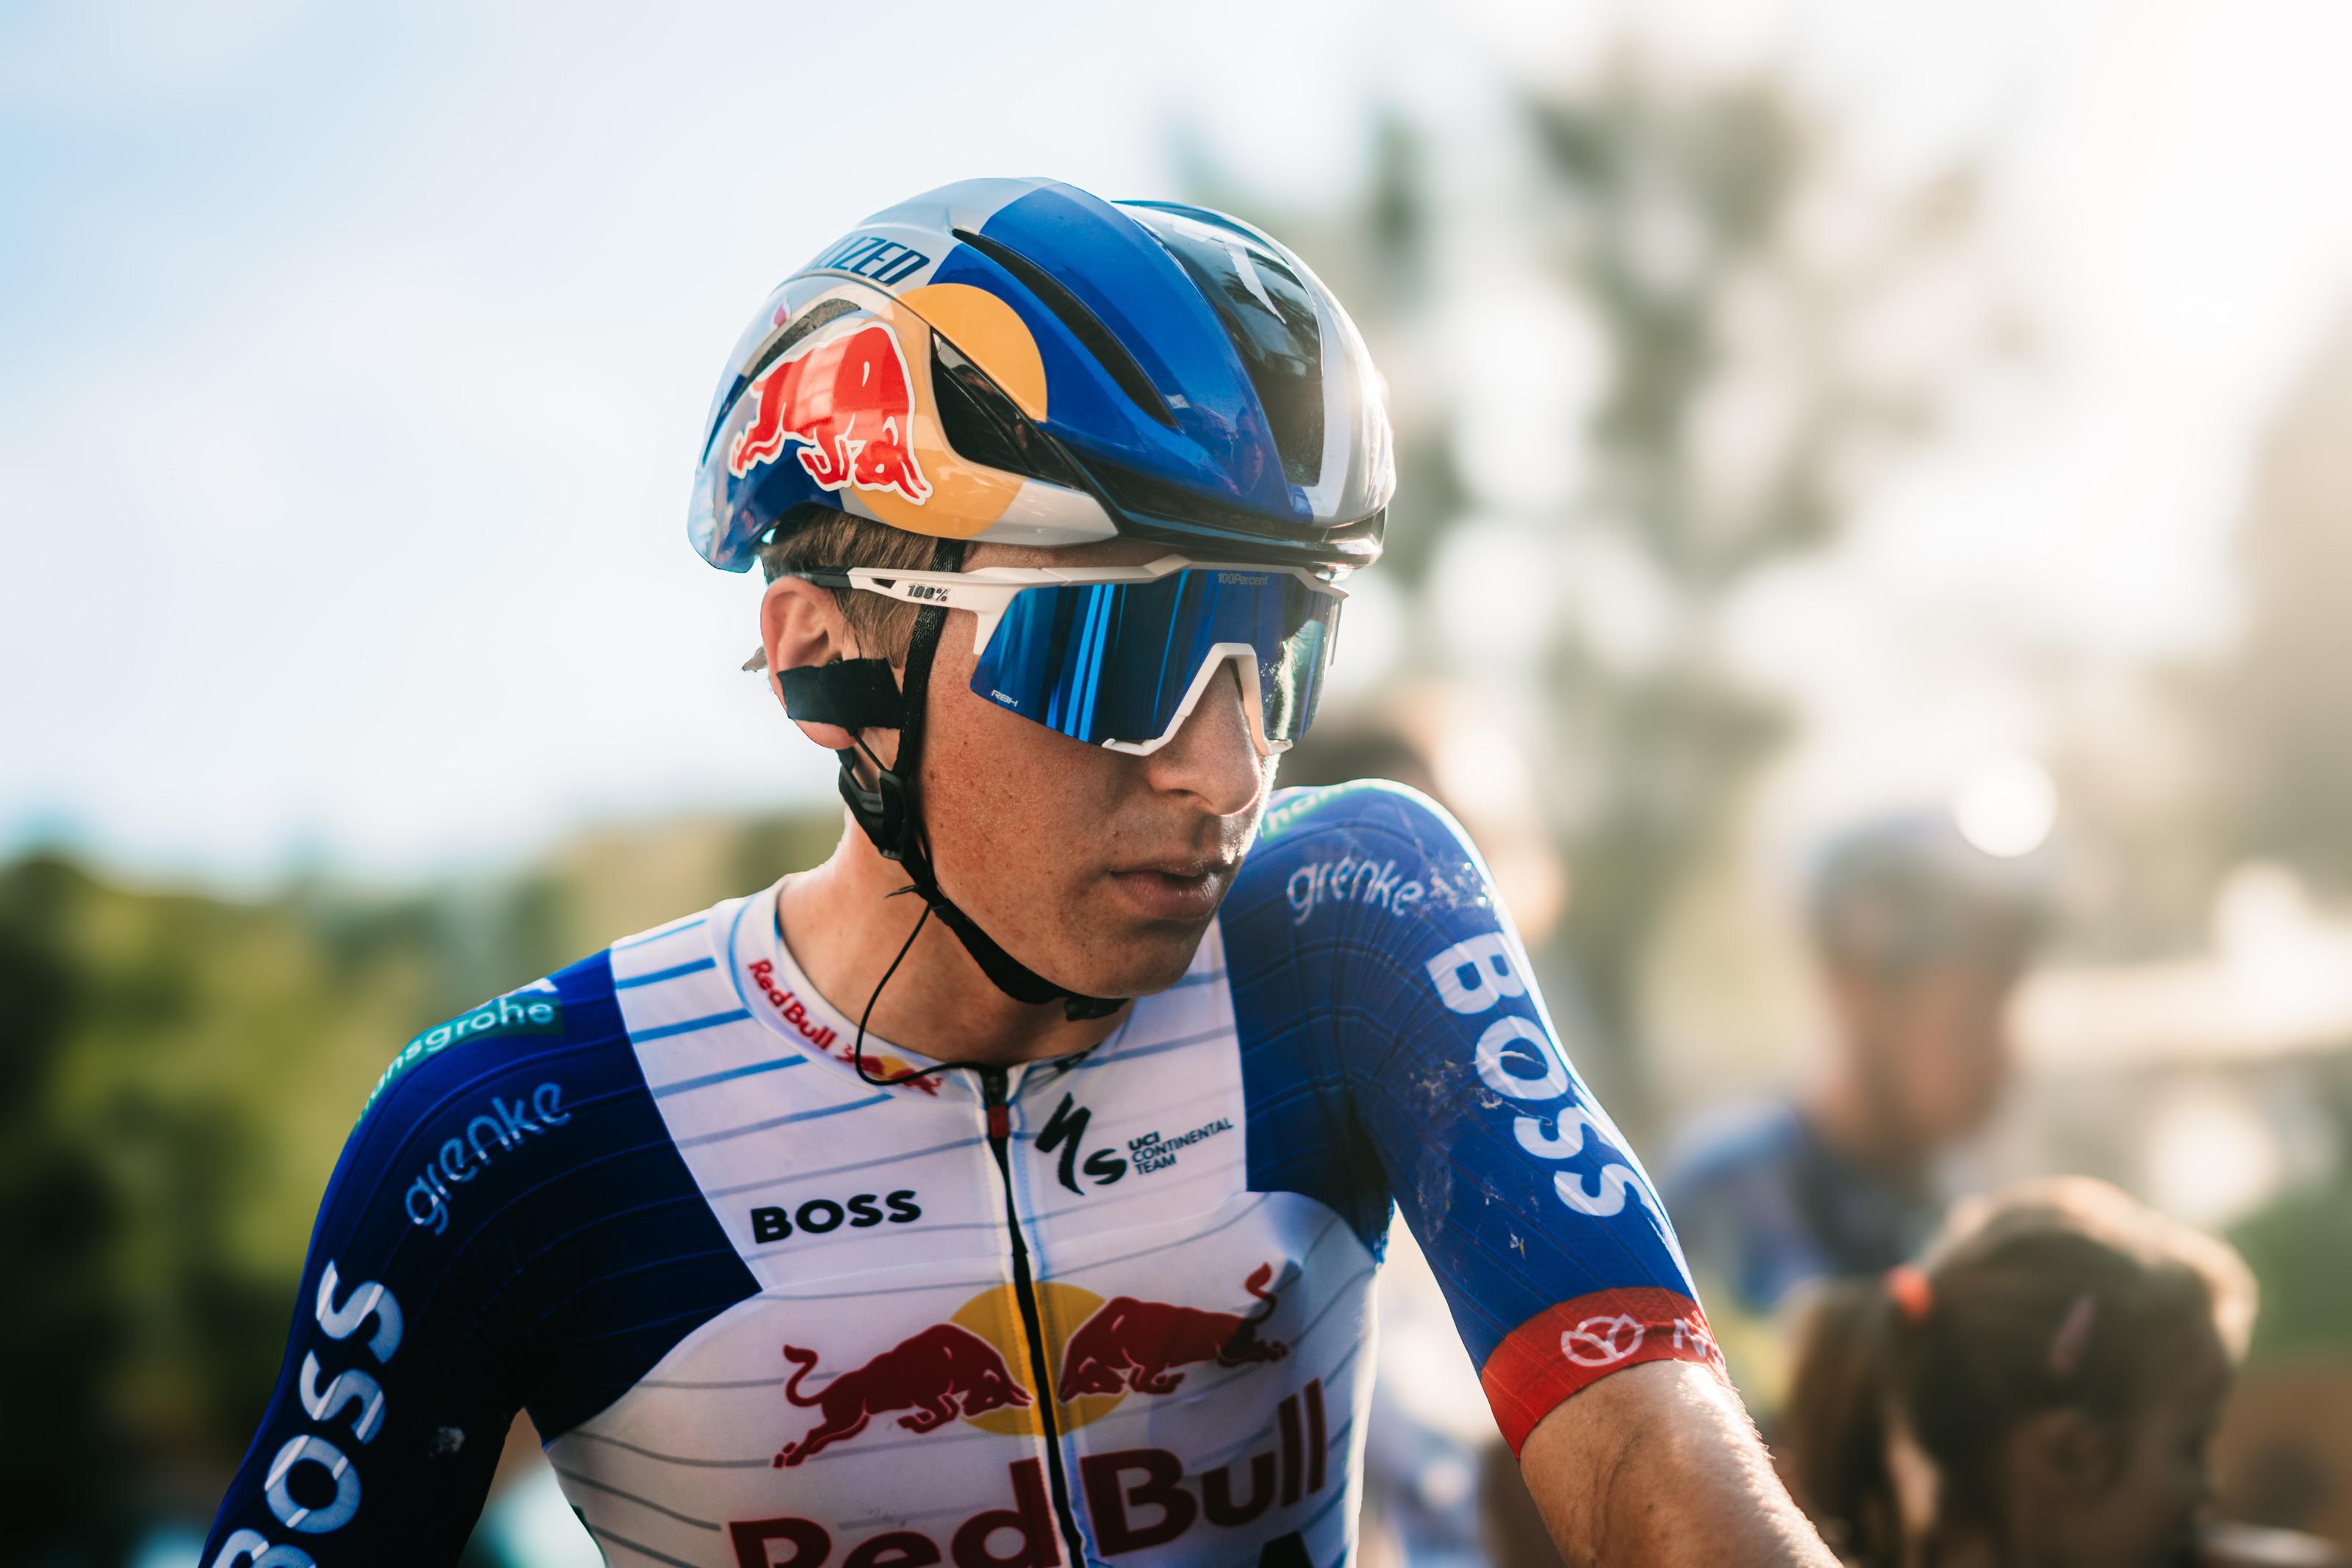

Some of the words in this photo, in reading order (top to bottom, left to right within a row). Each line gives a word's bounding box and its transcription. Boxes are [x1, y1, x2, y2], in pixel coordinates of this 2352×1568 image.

[808, 235, 931, 287] LIZED
[907, 583, 950, 602] 100%
[1217, 572, 1269, 586] 100Percent
[1287, 856, 1424, 925] grenke
[1426, 932, 1655, 1218] BOSS
[405, 1082, 571, 1235] grenke
[1128, 1132, 1161, 1151] UCI
[1132, 1118, 1234, 1163] CONTINENTAL
[1135, 1154, 1177, 1176] TEAM
[750, 1190, 922, 1244] BOSS
[1080, 1378, 1324, 1556] Bull
